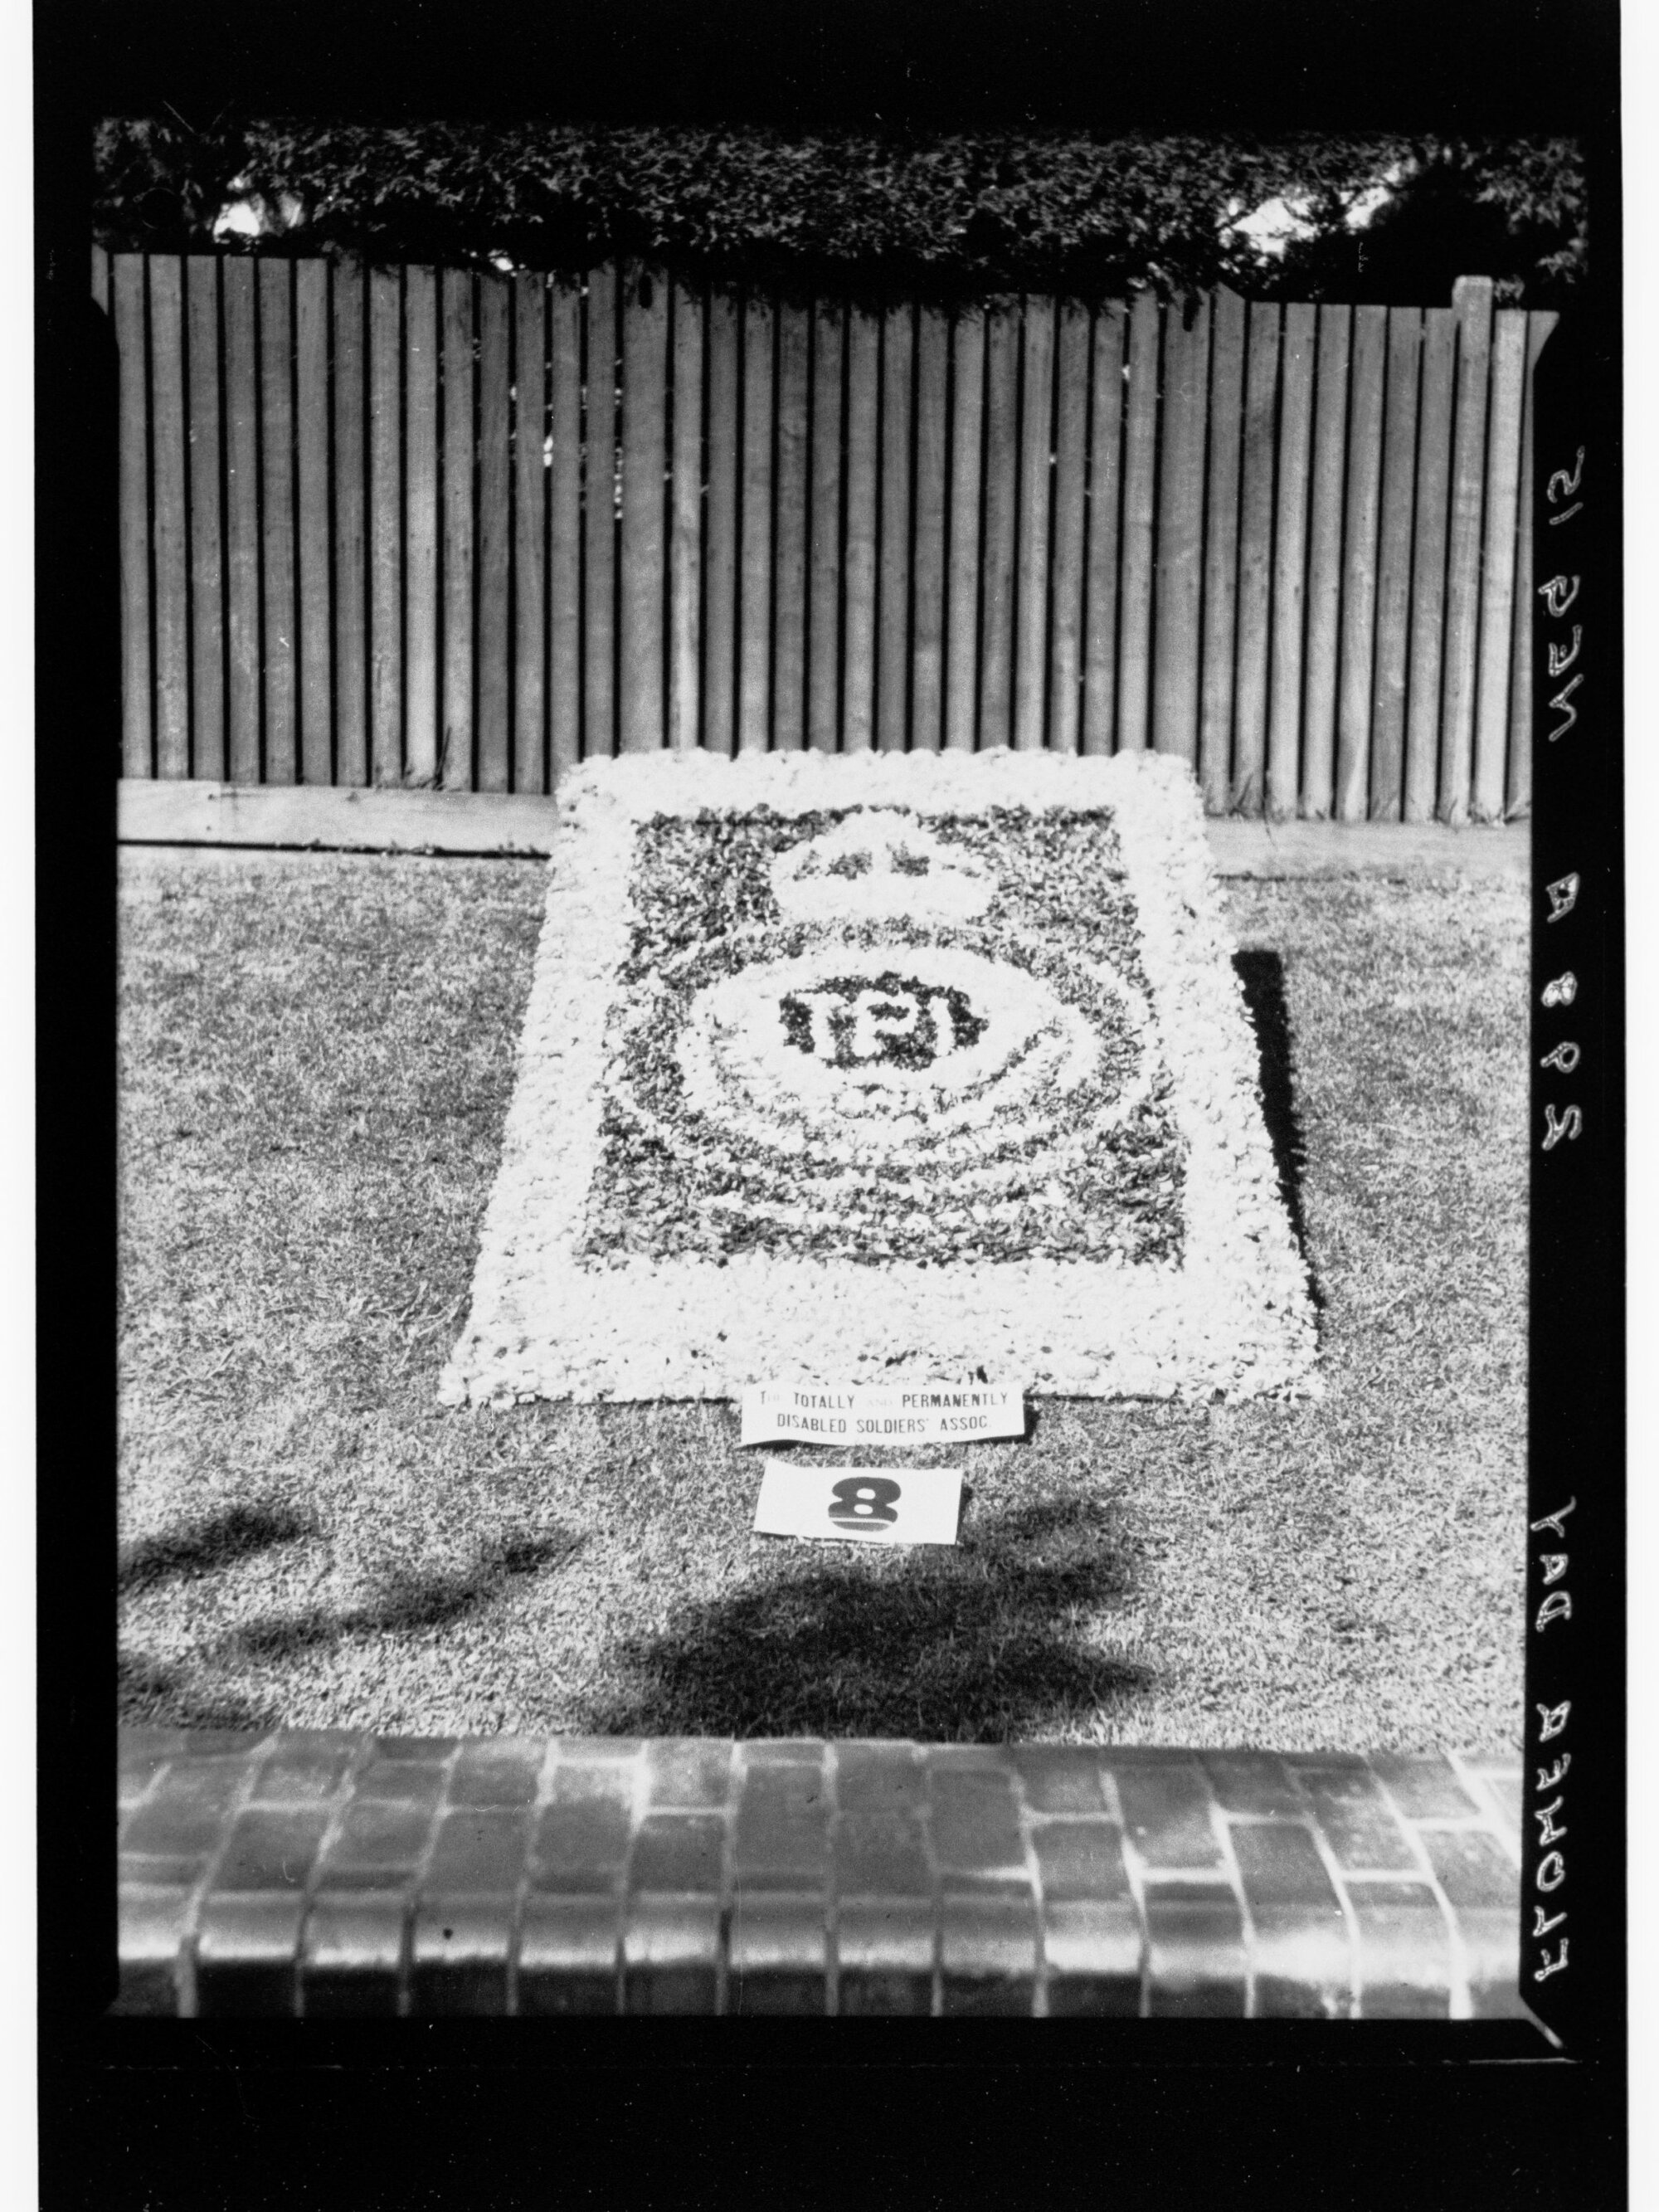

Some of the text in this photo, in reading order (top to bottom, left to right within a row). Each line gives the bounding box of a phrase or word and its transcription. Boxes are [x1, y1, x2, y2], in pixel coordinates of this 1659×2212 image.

[792, 990, 956, 1059] TPI
[793, 1391, 855, 1409] TOTALLY
[902, 1391, 1008, 1409] PERMANENTLY
[777, 1413, 847, 1434] DISABLED
[827, 1476, 902, 1532] 8
